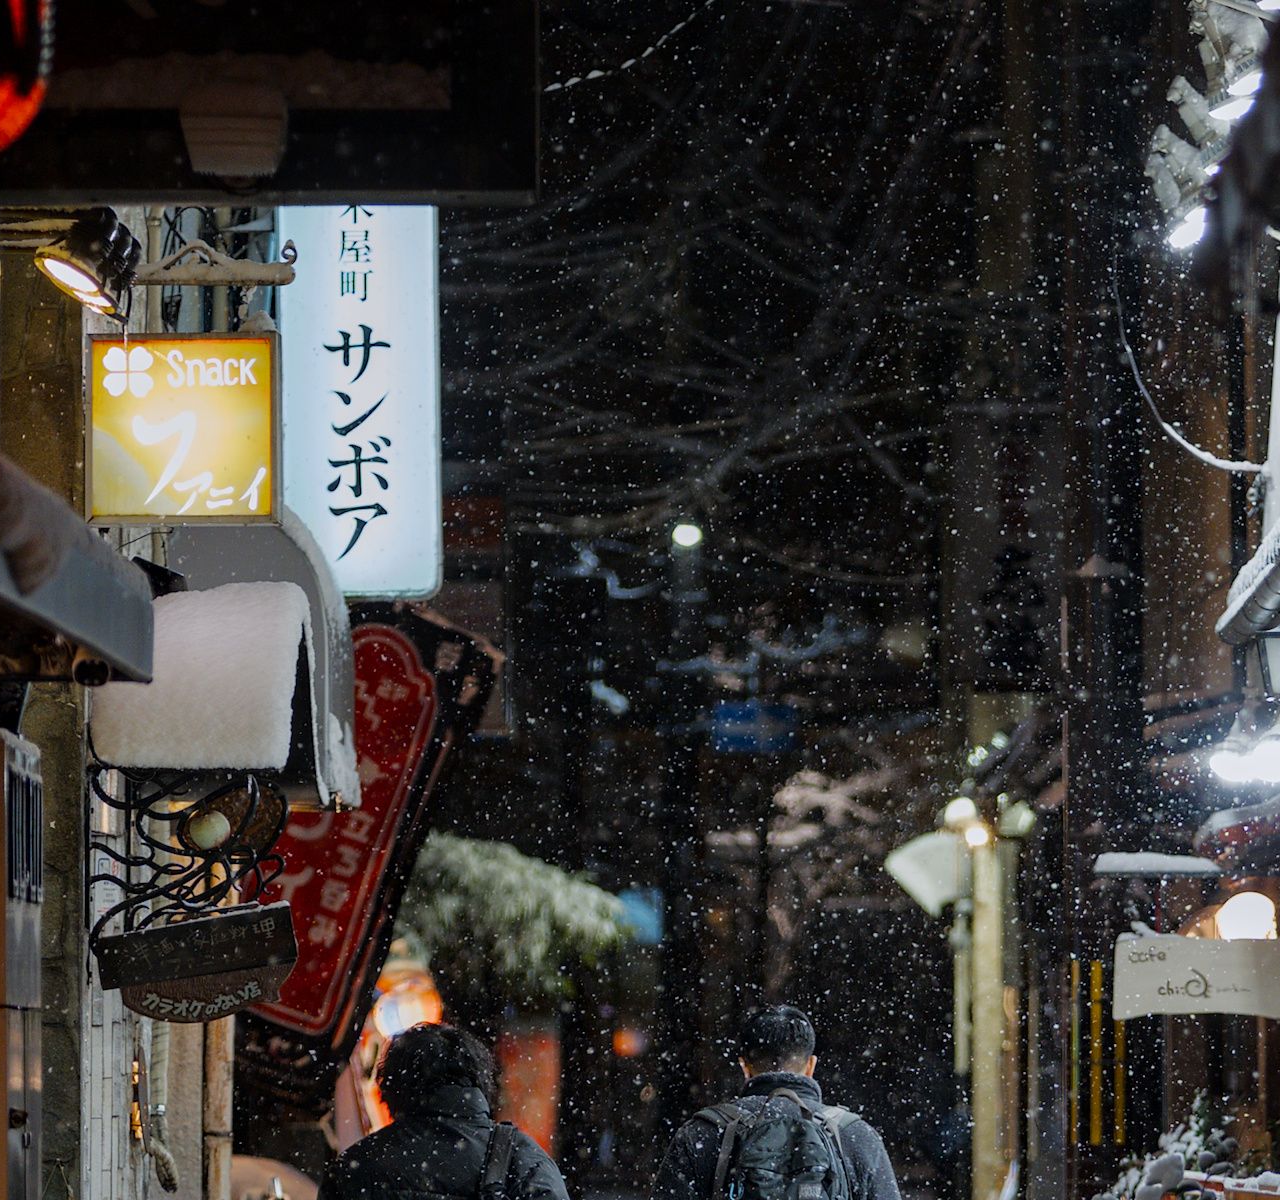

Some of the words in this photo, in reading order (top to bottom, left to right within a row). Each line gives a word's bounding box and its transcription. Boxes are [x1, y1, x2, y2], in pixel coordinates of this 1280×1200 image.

[166, 349, 258, 389] Snack
[322, 323, 391, 561] サンボア
[141, 980, 262, 1018] カラオケのない店
